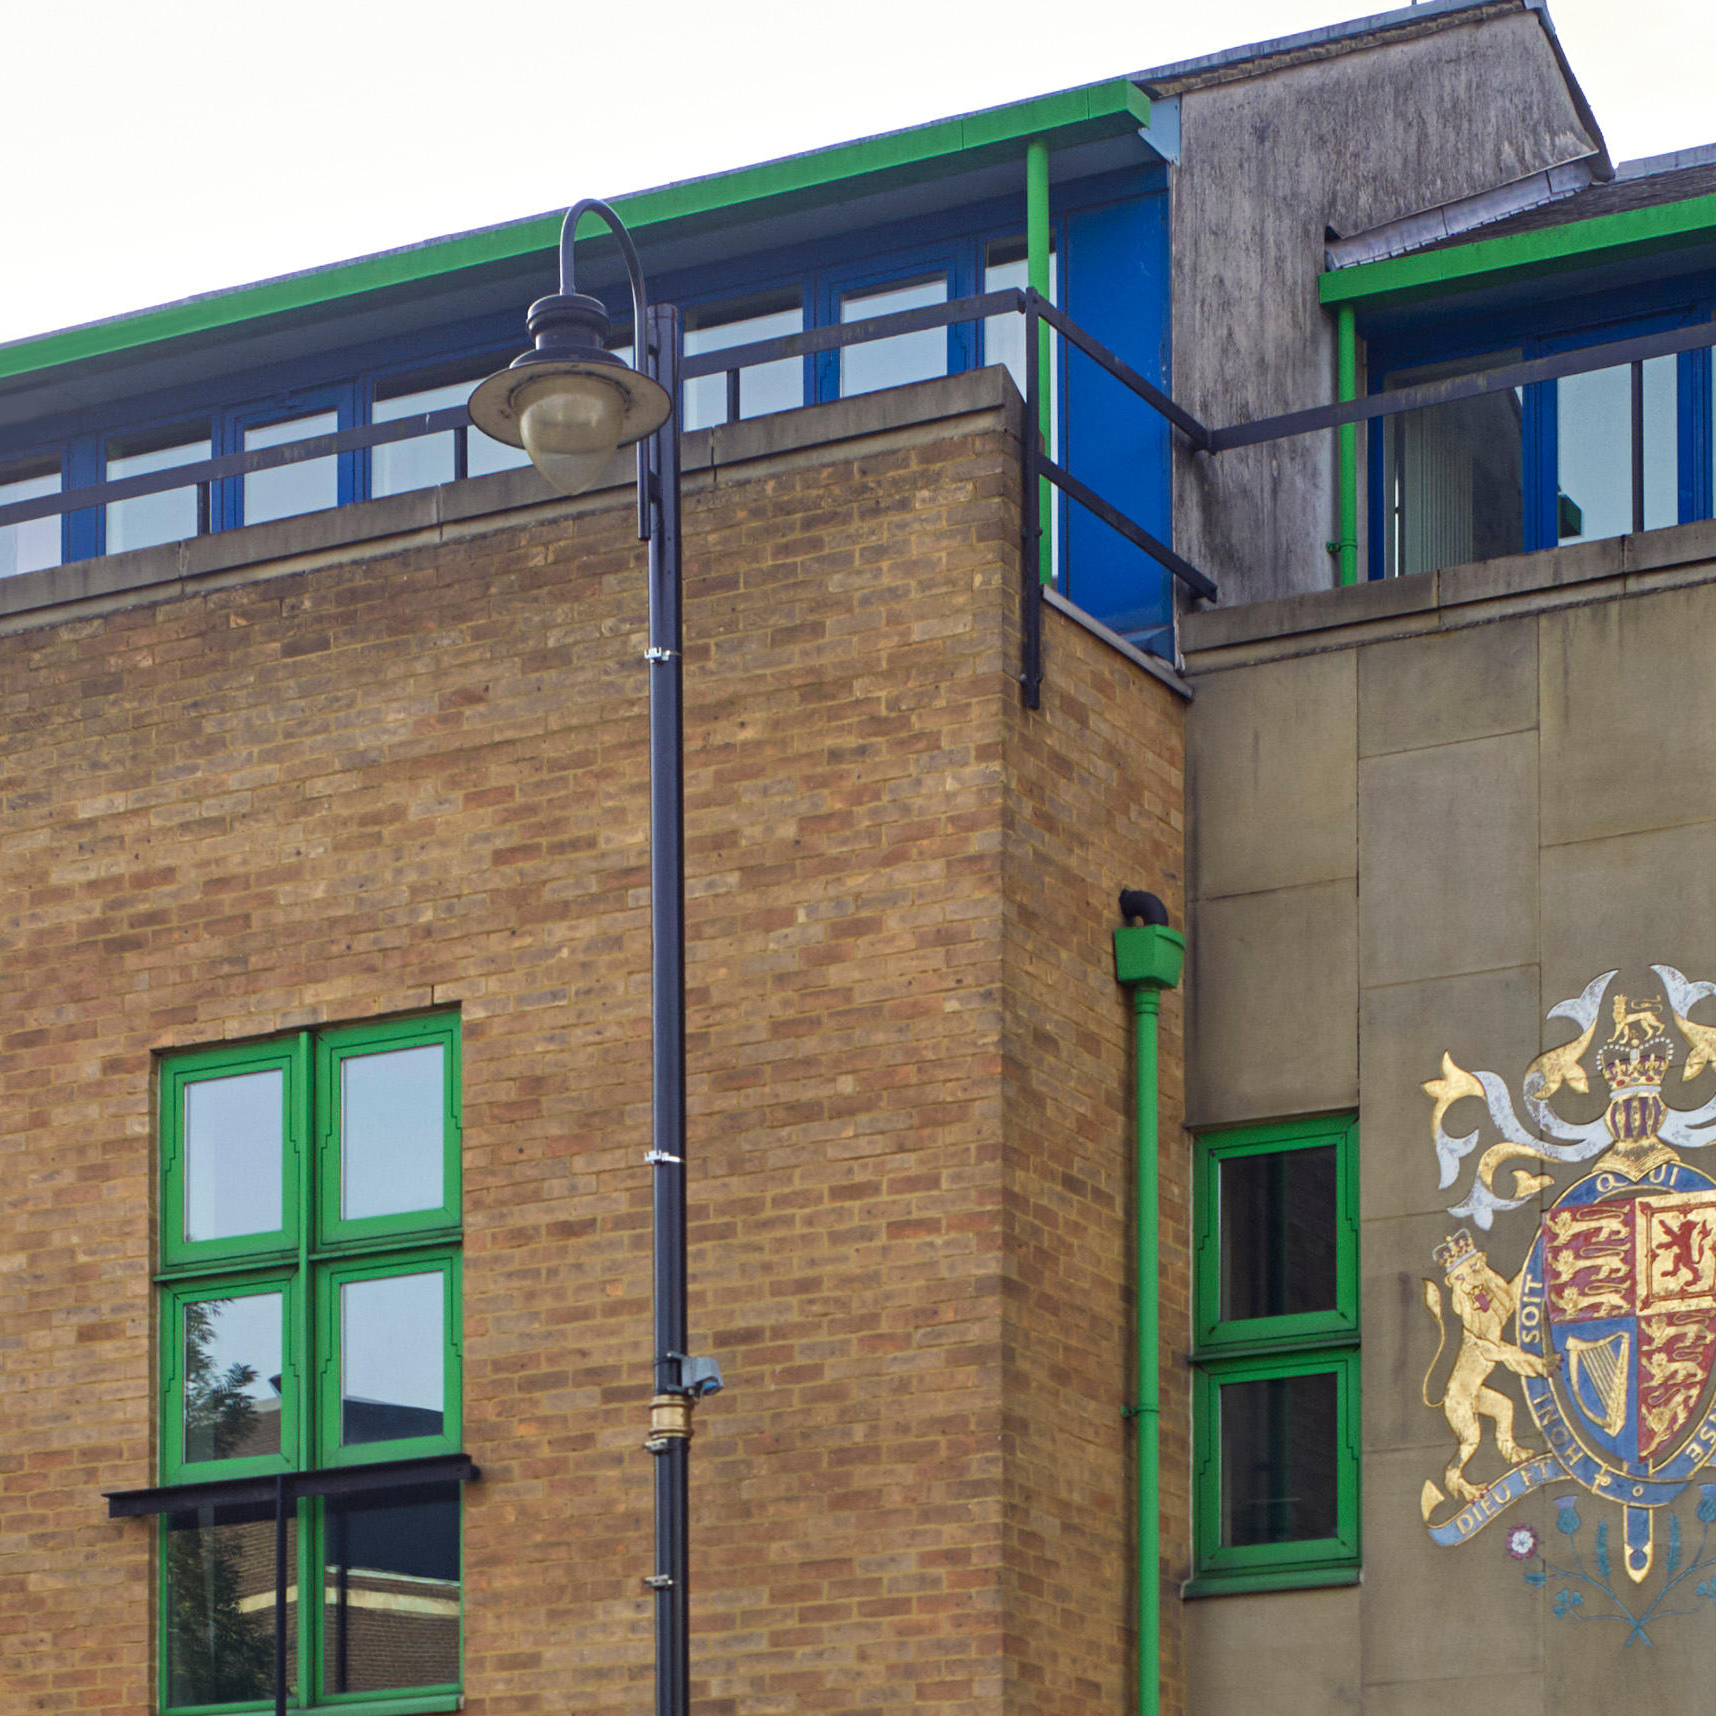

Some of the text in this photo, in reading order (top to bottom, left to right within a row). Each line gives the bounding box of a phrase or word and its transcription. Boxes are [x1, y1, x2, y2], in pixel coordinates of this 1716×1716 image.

[1596, 1163, 1679, 1192] QUI
[1521, 1273, 1543, 1344] SOIT
[1532, 1392, 1585, 1467] HONI
[1455, 1482, 1511, 1535] DIEU
[1520, 1459, 1551, 1486] ET
